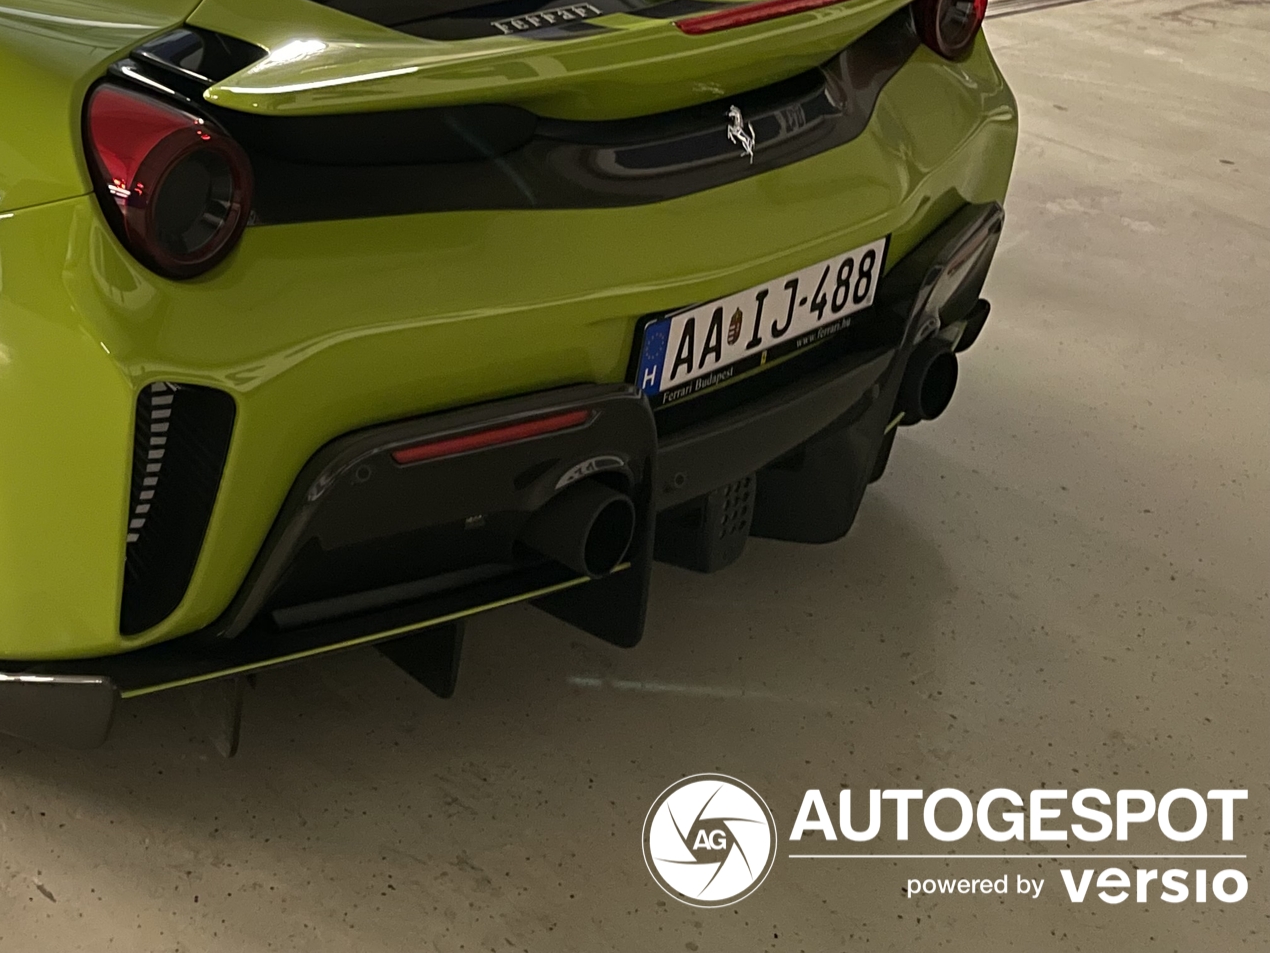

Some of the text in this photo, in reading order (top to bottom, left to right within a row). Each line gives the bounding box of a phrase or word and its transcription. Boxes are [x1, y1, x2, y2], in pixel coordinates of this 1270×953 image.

[641, 364, 658, 390] H
[662, 367, 734, 404] Ferrari Budapest
